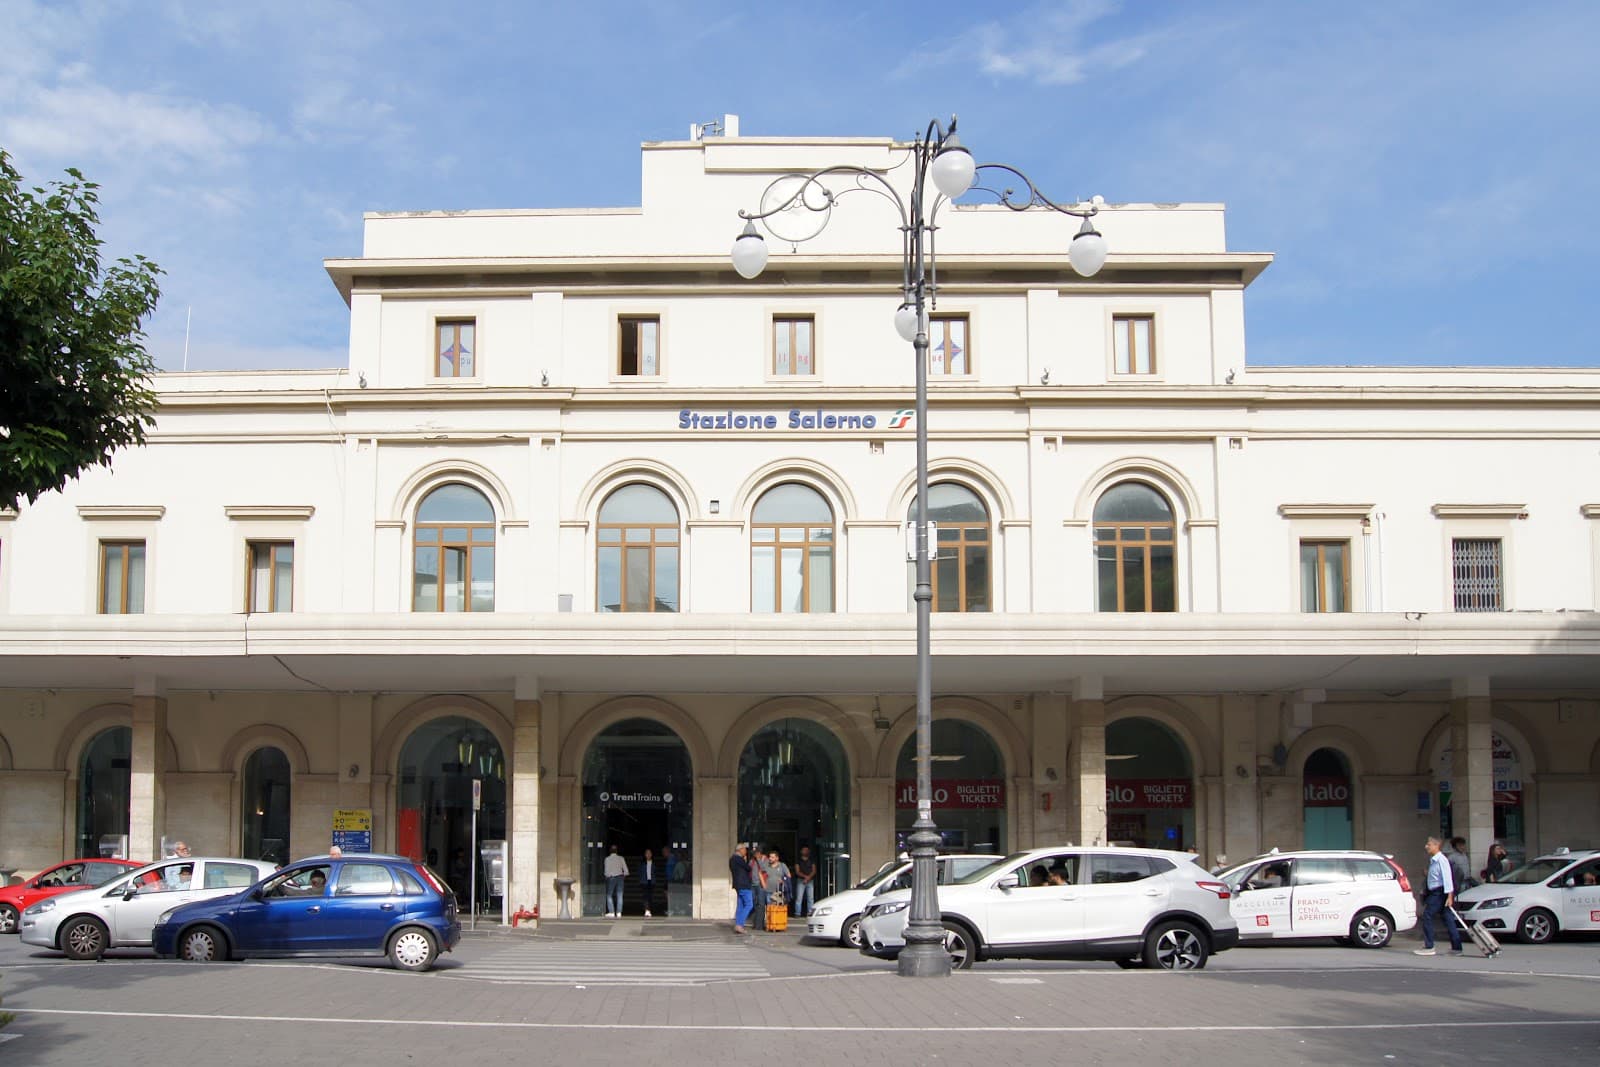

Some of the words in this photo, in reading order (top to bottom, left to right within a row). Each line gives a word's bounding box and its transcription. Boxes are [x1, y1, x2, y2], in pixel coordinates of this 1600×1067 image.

[679, 409, 777, 429] Stazione
[788, 409, 876, 429] Salerno
[956, 785, 1000, 794] BIGLIETTI
[1143, 785, 1186, 794] BIGLIETTI
[960, 794, 998, 803] TICKETS
[1147, 794, 1183, 802] TICKETS
[1297, 898, 1330, 906] PRANZO
[1298, 913, 1340, 921] APERITIVO
